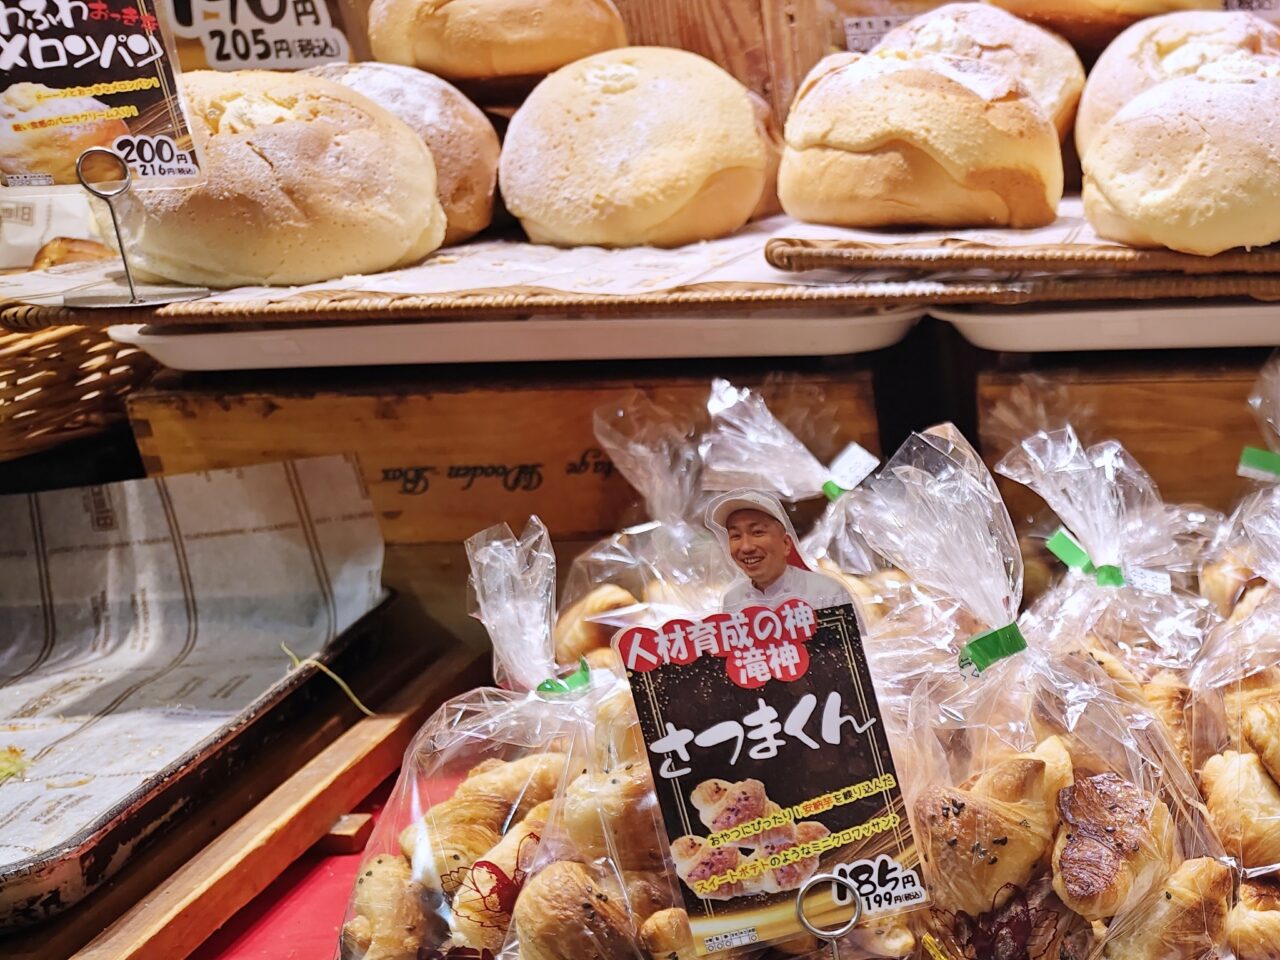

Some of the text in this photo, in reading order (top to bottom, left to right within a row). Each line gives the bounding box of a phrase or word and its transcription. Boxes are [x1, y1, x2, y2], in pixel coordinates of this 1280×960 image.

[116, 139, 188, 164] 200円
[626, 602, 815, 672] 人材育成の神
[733, 644, 801, 685] 滝神
[650, 690, 877, 779] さつまくん
[835, 857, 916, 901] 185円
